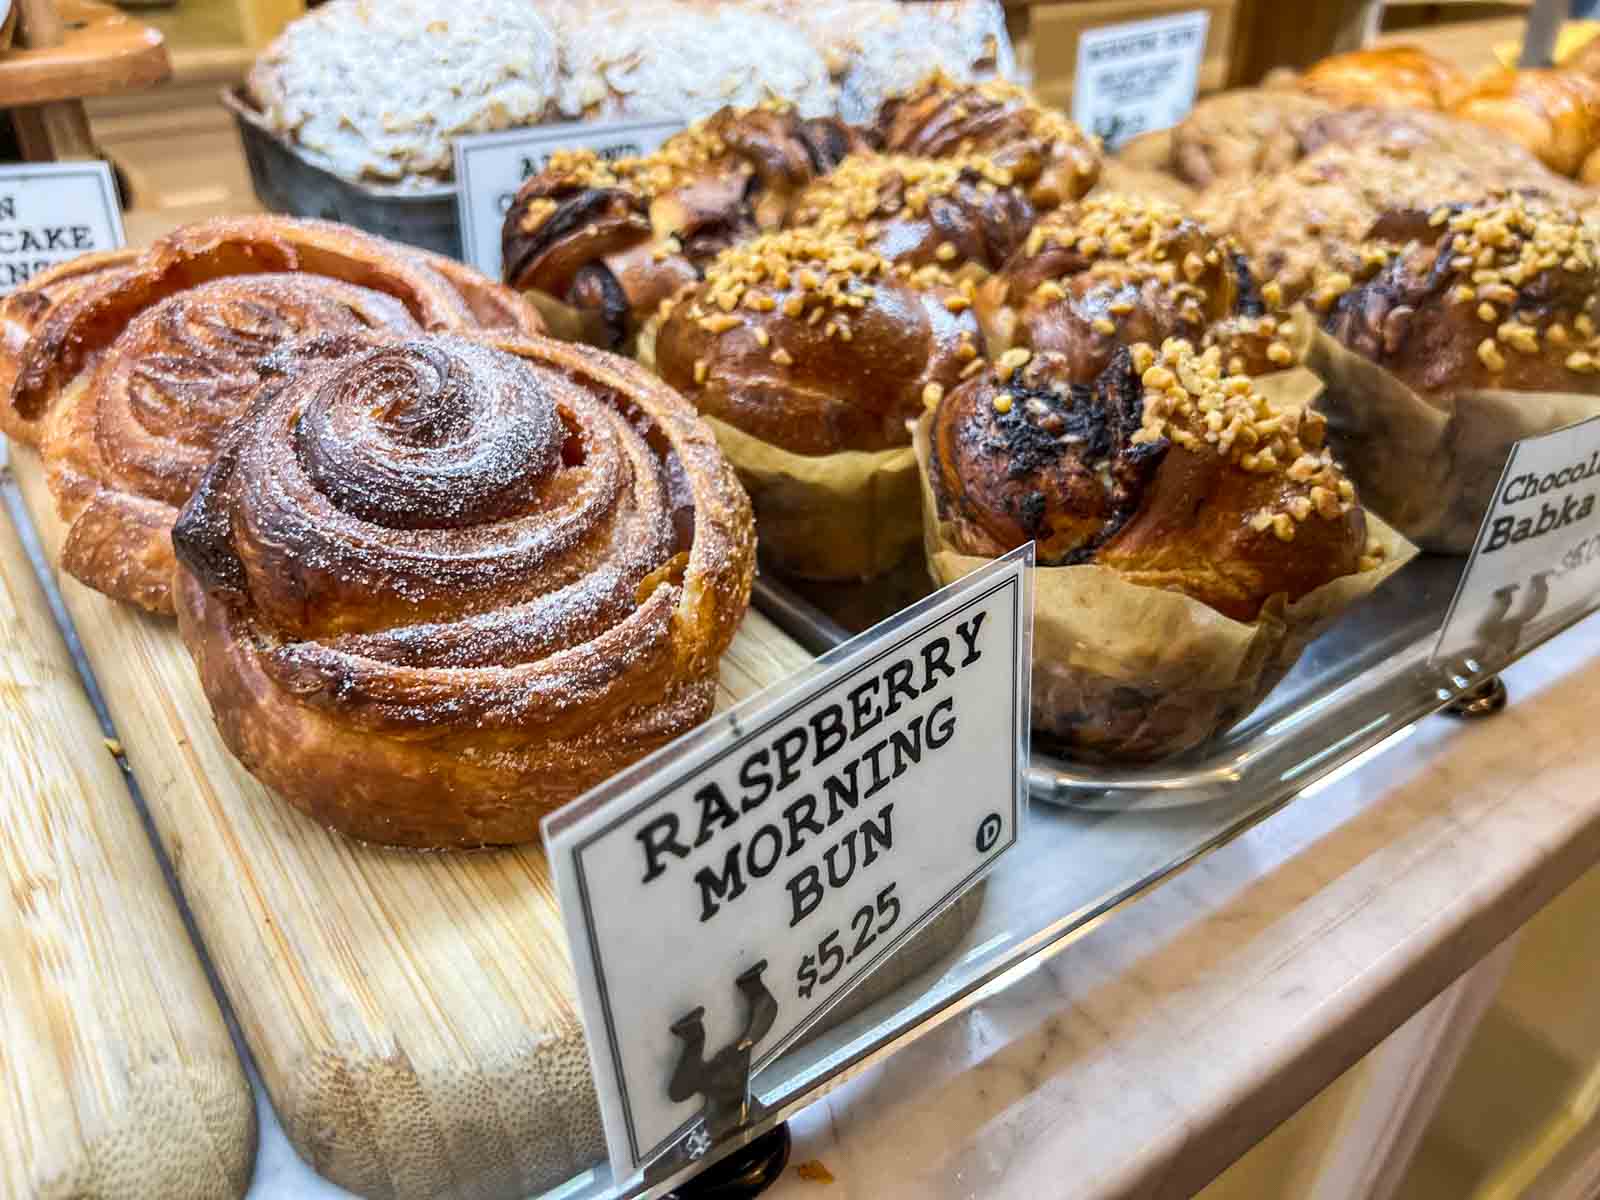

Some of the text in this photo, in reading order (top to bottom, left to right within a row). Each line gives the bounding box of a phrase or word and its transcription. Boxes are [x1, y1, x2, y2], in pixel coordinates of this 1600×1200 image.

[0, 225, 95, 254] CAKE
[1480, 493, 1595, 554] Babka
[1501, 450, 1600, 505] Chocol
[635, 611, 986, 884] RASPBERRY
[693, 696, 956, 922] MORNING
[785, 803, 894, 928] BUN
[797, 881, 901, 999] $5.25
